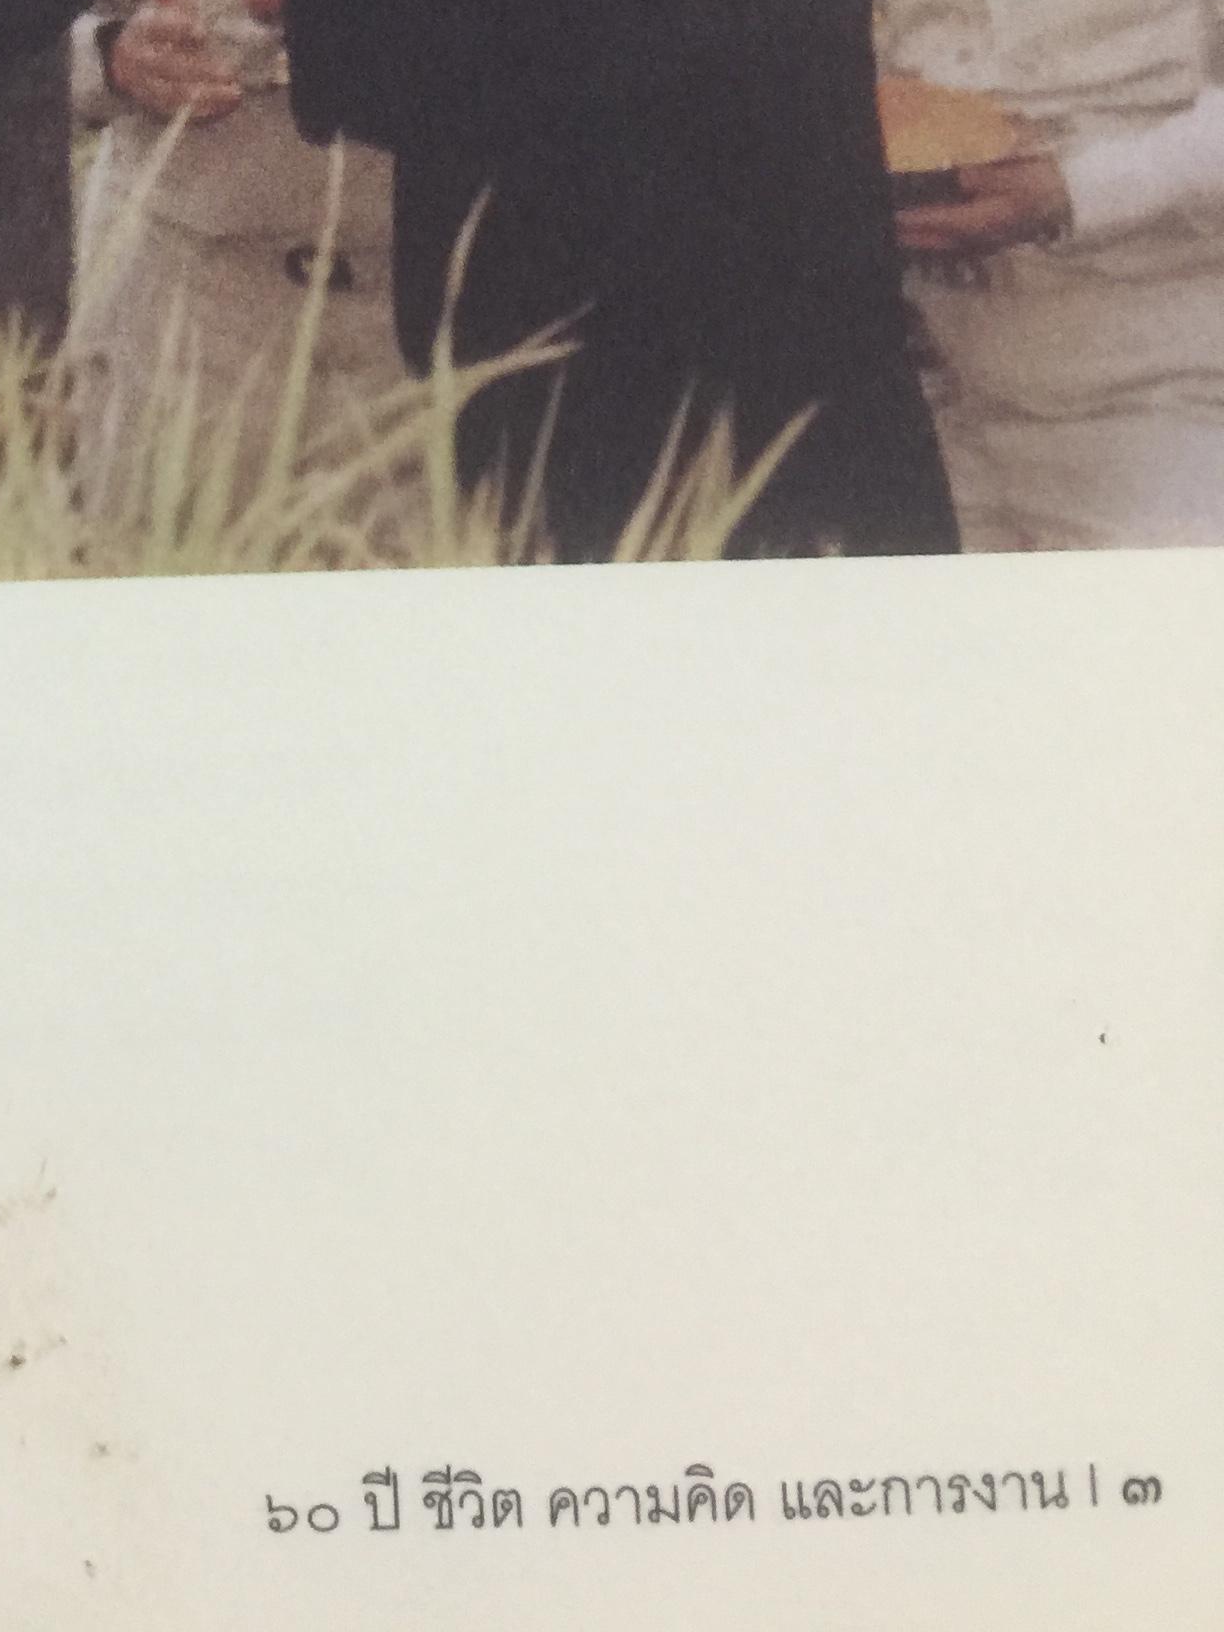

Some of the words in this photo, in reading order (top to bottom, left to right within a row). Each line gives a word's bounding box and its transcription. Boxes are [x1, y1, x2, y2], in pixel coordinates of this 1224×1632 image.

[264, 1492, 340, 1535] ๖๐
[360, 1463, 401, 1533] ปี
[419, 1462, 525, 1531] ชีวิต
[547, 1462, 756, 1529] ความคิด
[779, 1466, 1071, 1522] และการงาน
[1119, 1473, 1164, 1507] ๓
